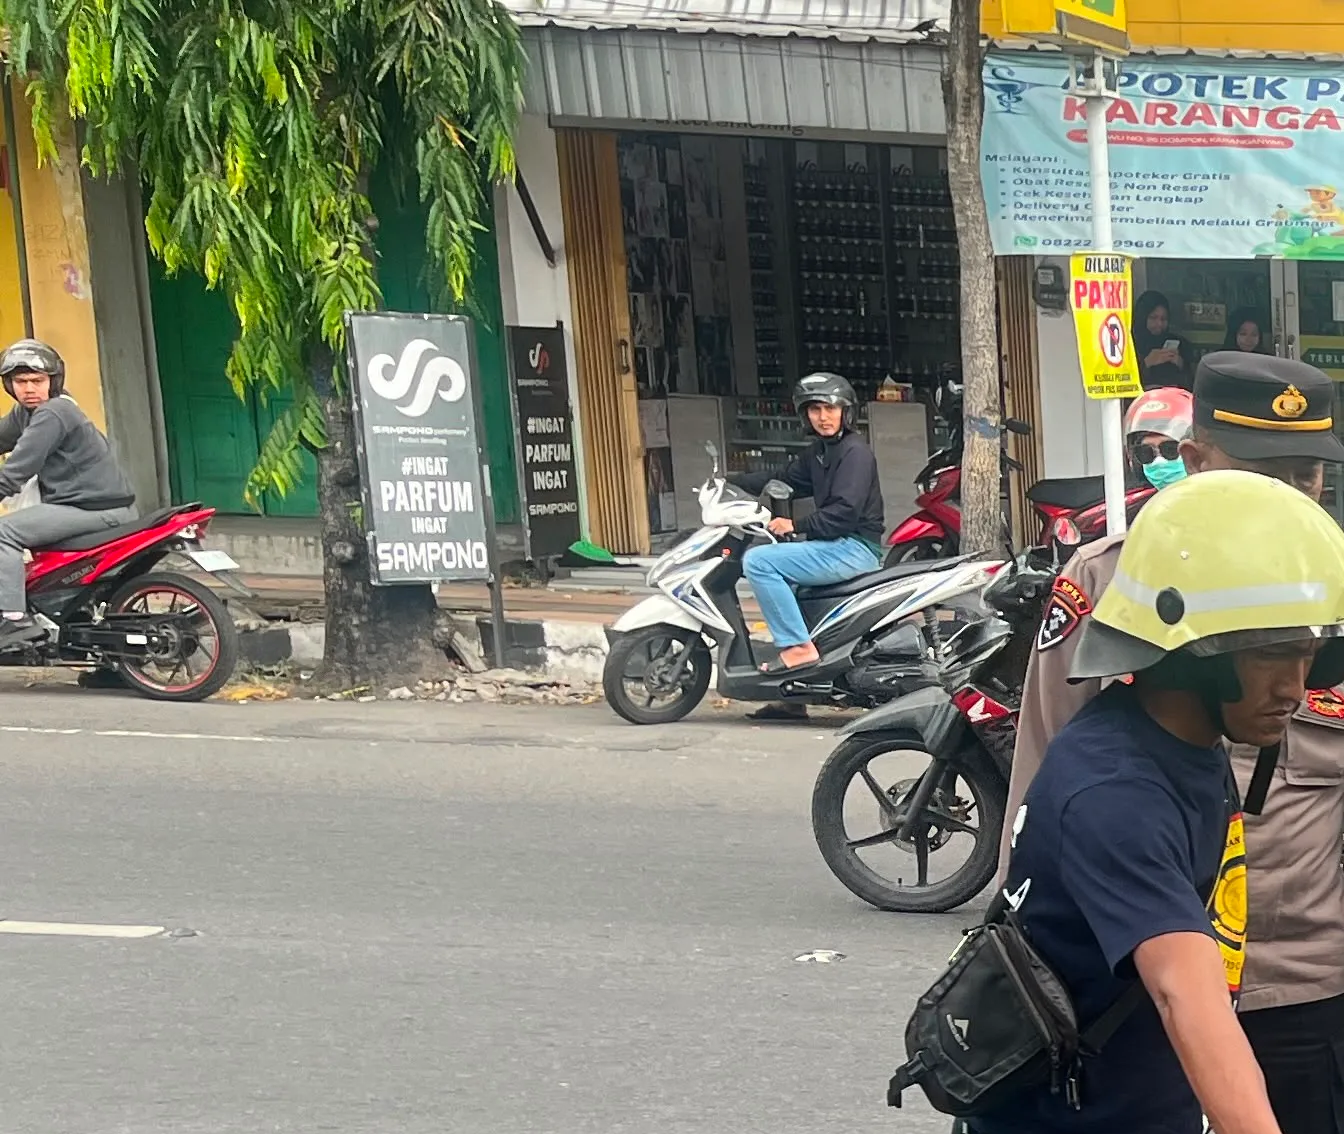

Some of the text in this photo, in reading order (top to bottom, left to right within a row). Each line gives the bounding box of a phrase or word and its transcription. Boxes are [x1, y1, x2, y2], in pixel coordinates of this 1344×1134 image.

[985, 153, 1059, 164] Melayani
[1012, 166, 1091, 177] Konsultas
[1182, 171, 1231, 181] Gratis
[1012, 177, 1050, 187] Obat
[1054, 178, 1092, 188] Rese
[1123, 182, 1157, 191] Non
[1161, 183, 1209, 193] Resep
[1012, 189, 1204, 205] Cek Kesehan Lengkap
[1013, 201, 1080, 212] Delivery
[1110, 216, 1186, 226] embelian
[1190, 218, 1251, 227] Melalui
[1255, 218, 1336, 228] Grabmart
[372, 425, 434, 436] SAMPONO
[526, 416, 566, 436] #INGAT
[525, 443, 572, 465] PARFUM
[401, 456, 449, 476] #INGAT
[532, 469, 569, 491] INGAT
[379, 480, 475, 513] PARFUM
[528, 501, 578, 516] SAMPONO
[411, 516, 448, 535] INGAT
[376, 539, 489, 574] SAMPONO
